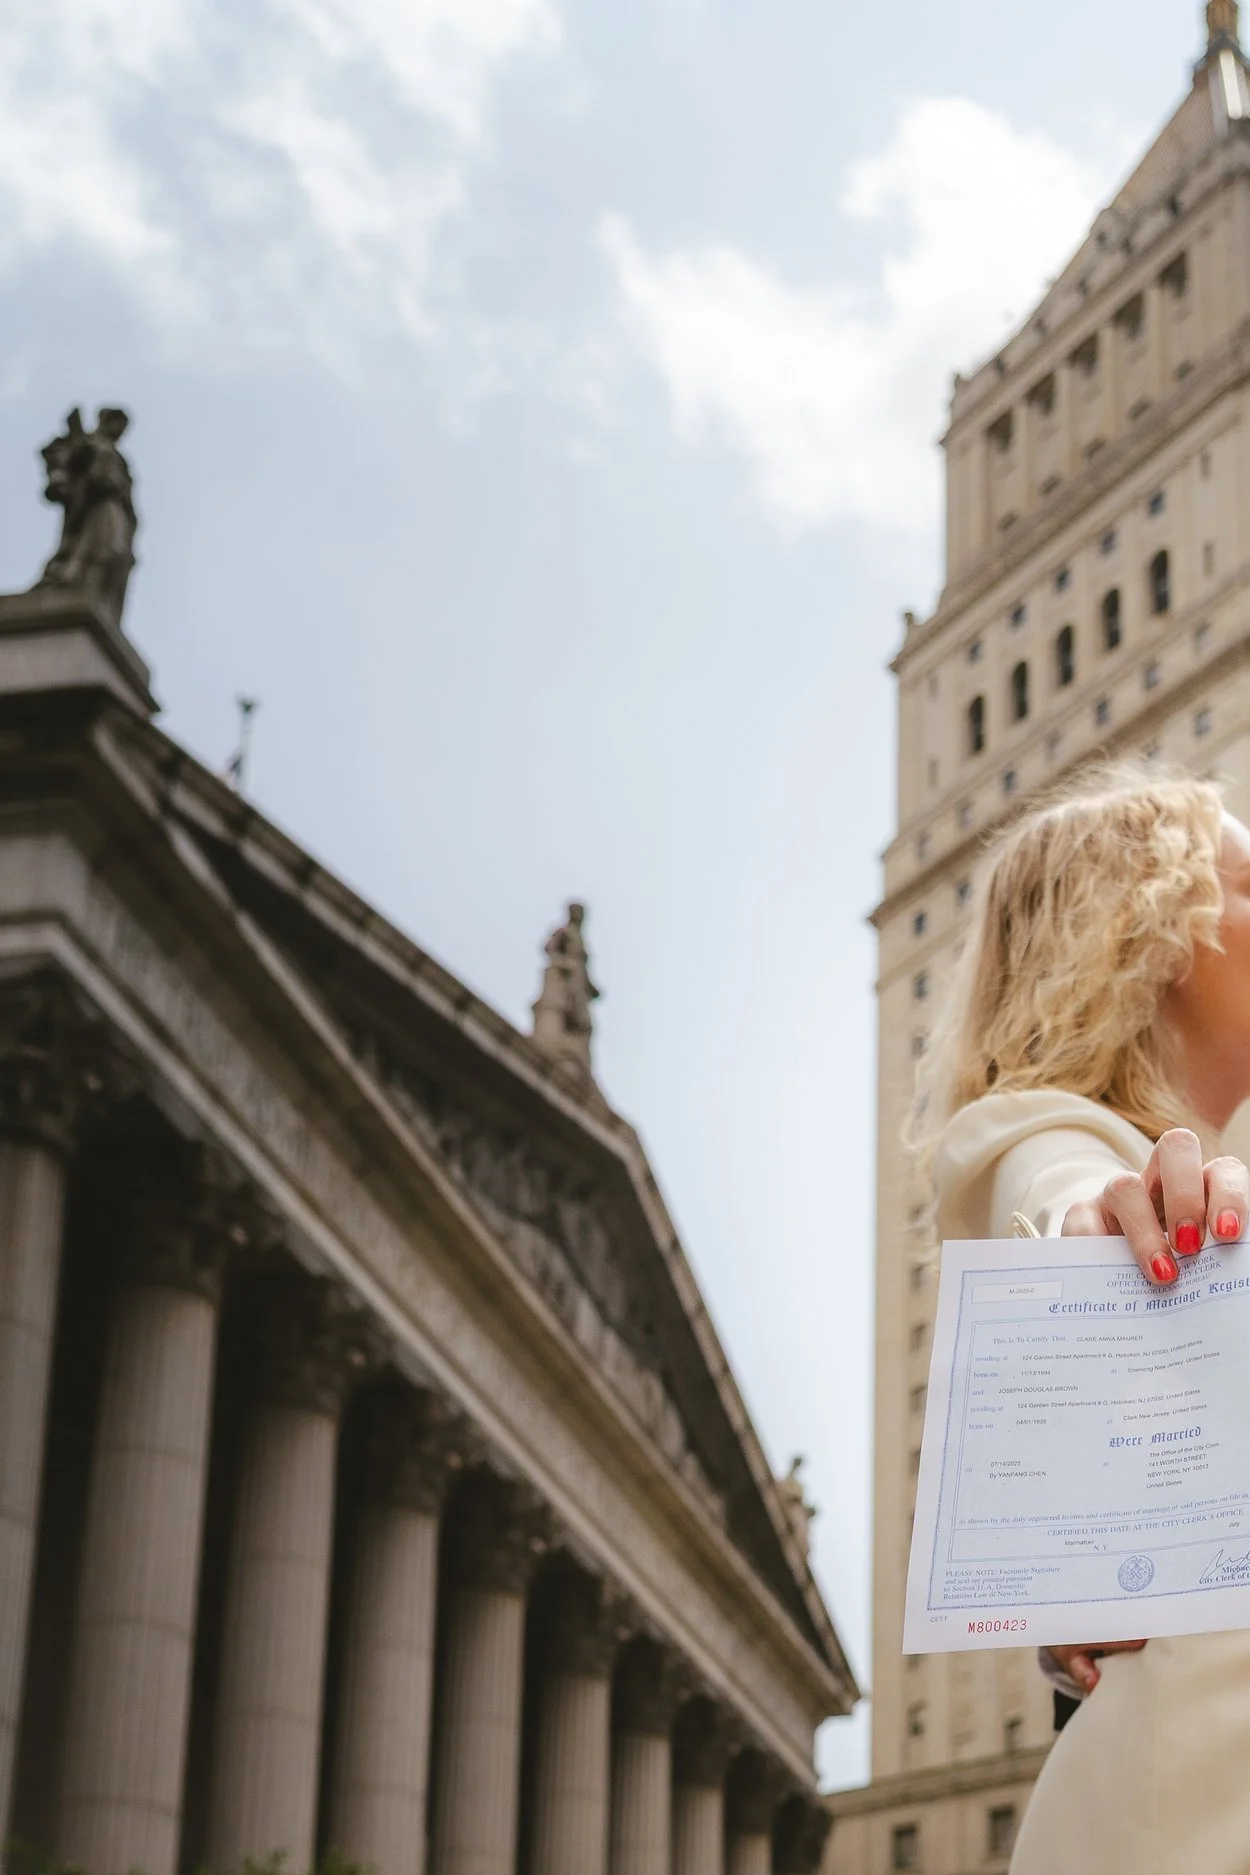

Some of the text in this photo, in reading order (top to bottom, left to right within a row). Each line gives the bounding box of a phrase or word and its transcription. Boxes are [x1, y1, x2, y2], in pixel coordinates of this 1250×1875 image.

[1192, 1255, 1215, 1268] YORK
[1106, 1280, 1140, 1288] OFFICE
[1193, 1260, 1222, 1275] CLERK
[1119, 1288, 1158, 1296] MARRIAGE
[1185, 1274, 1210, 1287] BUREAU
[1048, 1301, 1117, 1314] Certificate
[1125, 1300, 1138, 1312] of
[1145, 1289, 1201, 1311] Marriage
[1026, 1336, 1048, 1344] Certify
[1170, 1343, 1186, 1352] United
[1186, 1339, 1203, 1348] States
[1185, 1355, 1202, 1364] United
[1203, 1351, 1220, 1360] States
[998, 1384, 1079, 1394] JOSEPH DOUGLAS BROWN
[1067, 1400, 1097, 1408] Apartment
[1166, 1391, 1183, 1400] United
[1183, 1388, 1200, 1397] States
[1172, 1406, 1190, 1415] United
[1190, 1403, 1207, 1412] States
[1109, 1426, 1201, 1448] Were Married
[1160, 1449, 1176, 1457] Office
[1159, 1457, 1182, 1467] WORTH
[1182, 1453, 1207, 1463] STREET
[1028, 1470, 1047, 1478] CHEN
[1164, 1479, 1182, 1487] States
[967, 1517, 989, 1525] shown
[990, 1517, 998, 1525] by
[1012, 1515, 1026, 1523] duly
[1028, 1514, 1060, 1523] registered
[1061, 1513, 1085, 1521] license
[1099, 1509, 1132, 1519] certificate
[1142, 1505, 1171, 1515] marriage
[1180, 1500, 1193, 1509] said
[1194, 1498, 1218, 1509] persons
[1229, 1493, 1241, 1501] file
[1046, 1527, 1088, 1537] CERTIFIED
[1090, 1526, 1108, 1535] THIS
[1110, 1525, 1131, 1533] DATE
[1132, 1523, 1144, 1532] AT
[1144, 1521, 1161, 1531] THE
[1161, 1518, 1181, 1528] CITY
[1215, 1509, 1244, 1519] OFFICE
[945, 1569, 974, 1577] PLEASE
[999, 1567, 1029, 1575] Facsimile
[1030, 1566, 1061, 1576] Signature
[1214, 1573, 1236, 1582] Clerk
[1236, 1572, 1246, 1580] of
[982, 1576, 1005, 1585] printed
[1005, 1575, 1033, 1584] pursuant
[995, 1583, 1025, 1591] Domestic
[943, 1592, 972, 1600] Relations
[968, 1619, 1028, 1634] M800423
